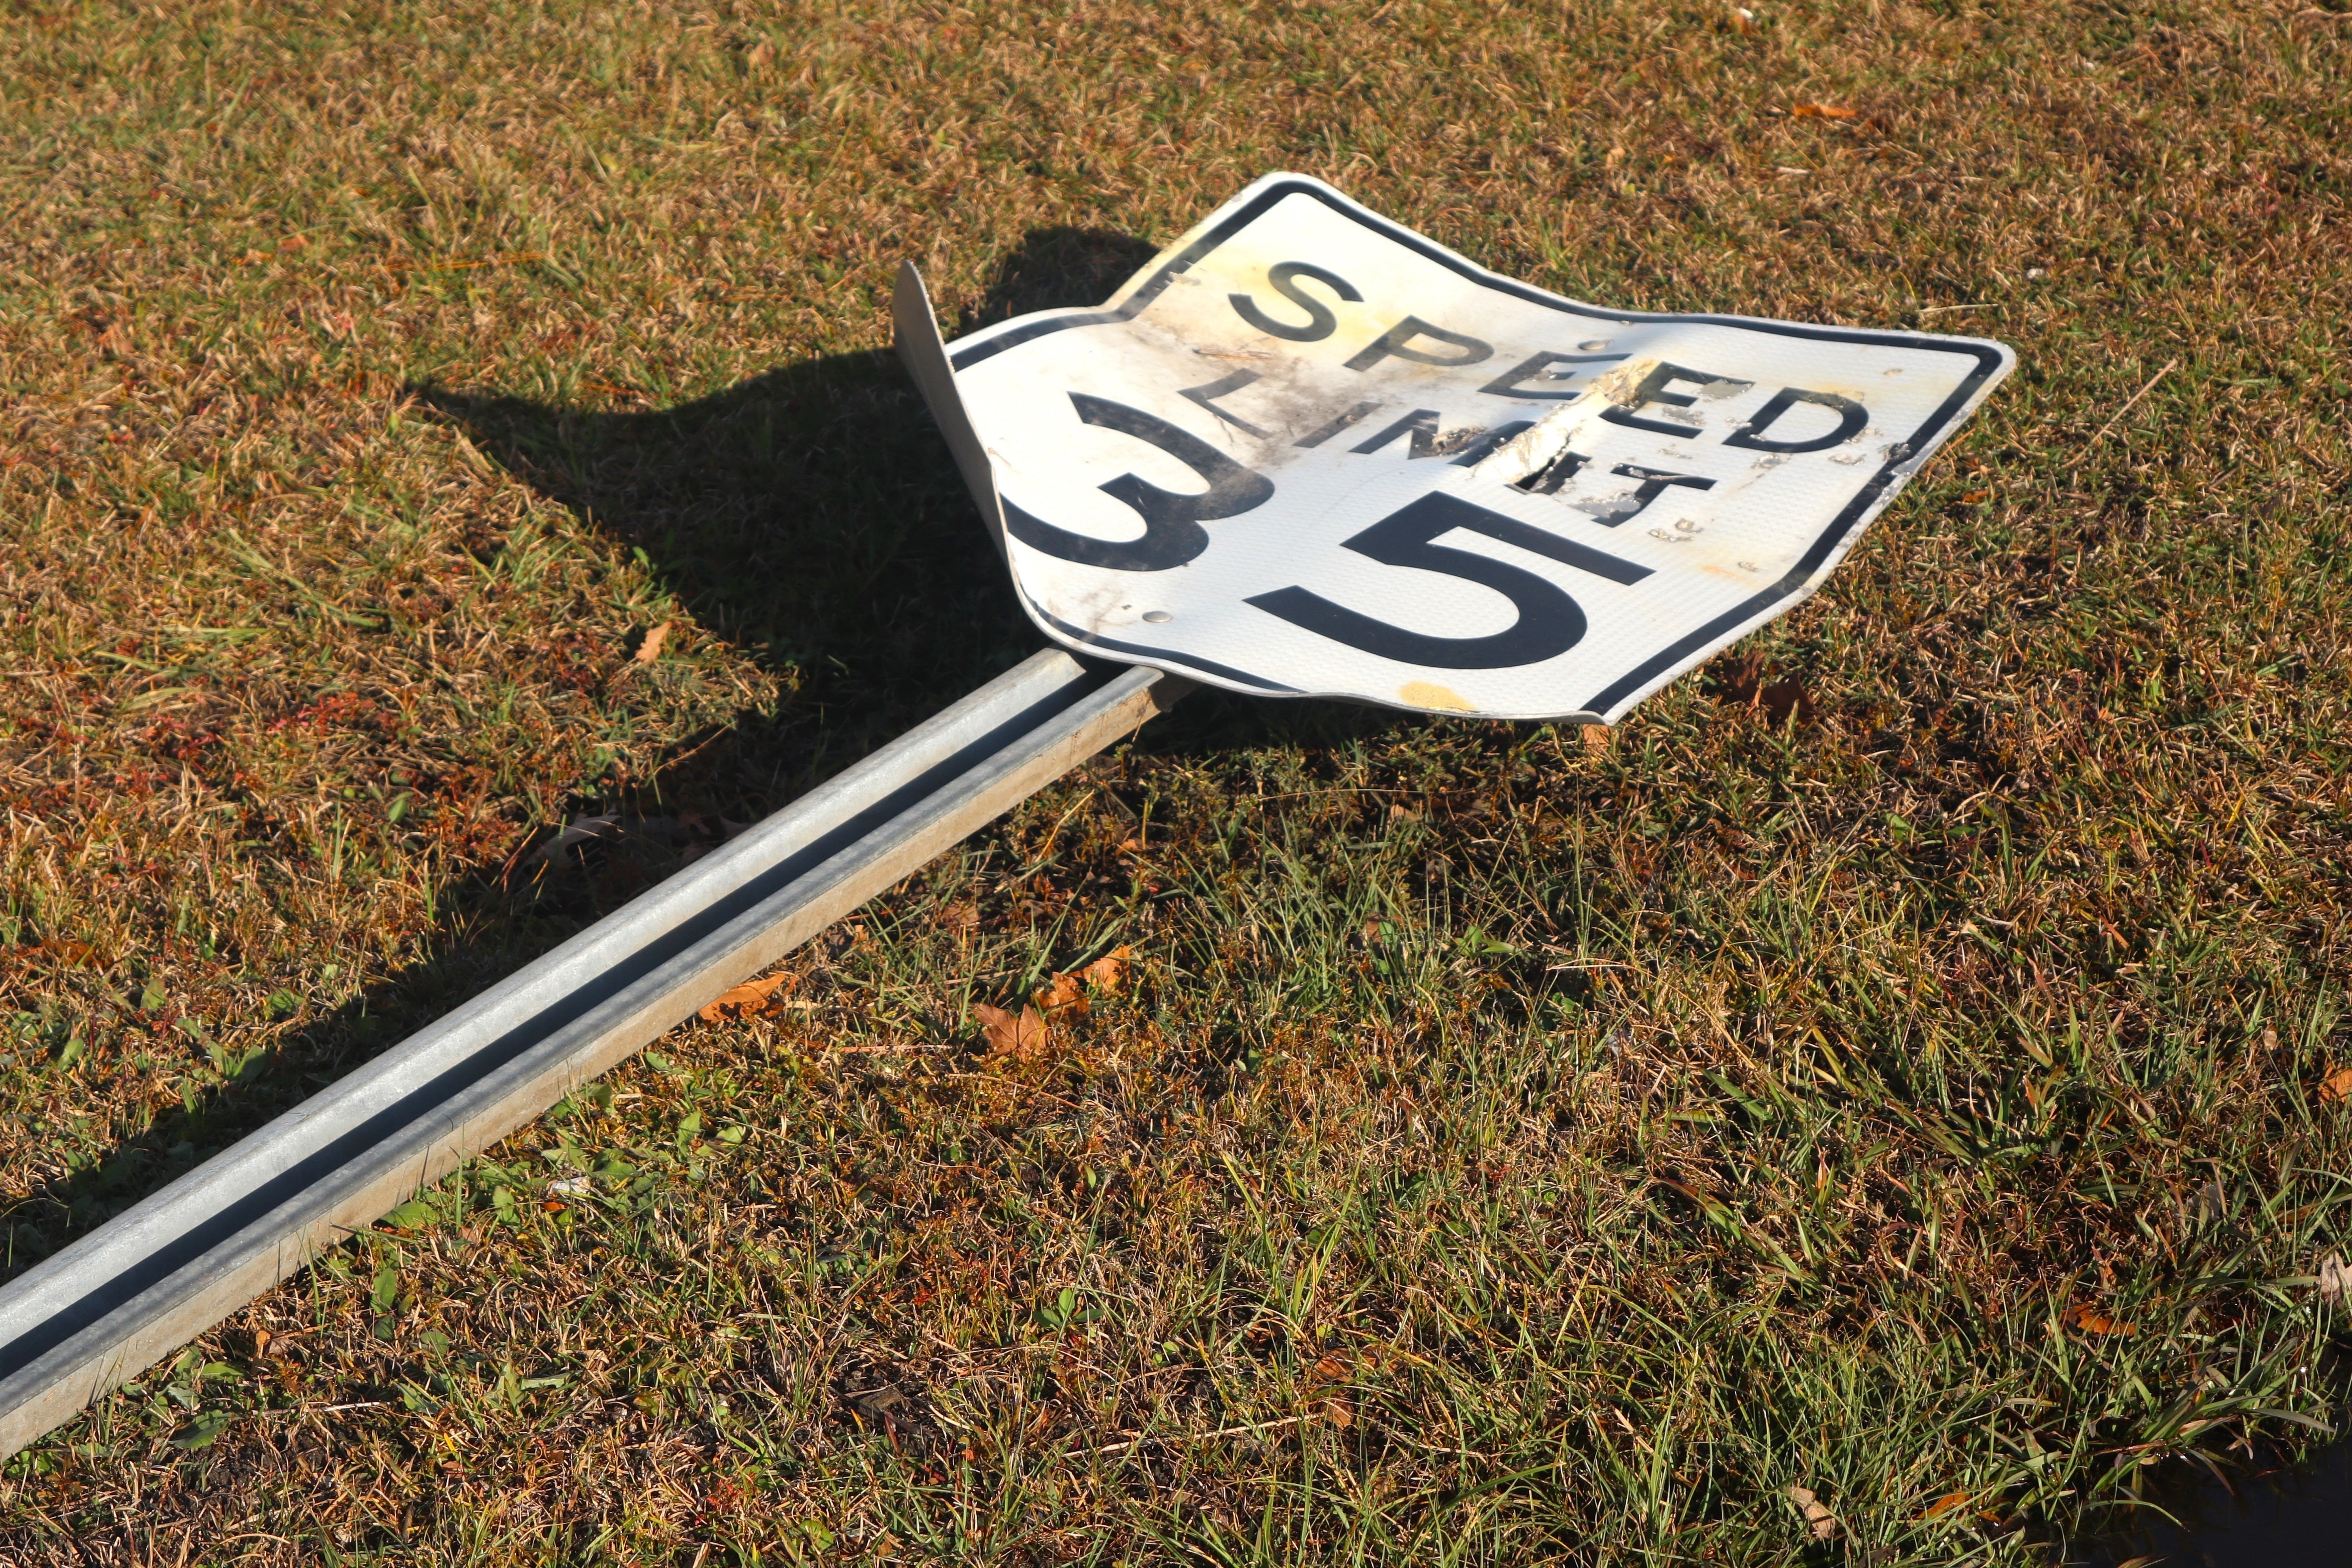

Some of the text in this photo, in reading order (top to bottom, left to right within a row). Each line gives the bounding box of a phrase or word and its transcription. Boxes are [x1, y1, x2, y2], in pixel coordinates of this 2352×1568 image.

[1177, 368, 1718, 528] LIMIT
[1228, 261, 1869, 454] SPEED
[999, 391, 1657, 670] 35
